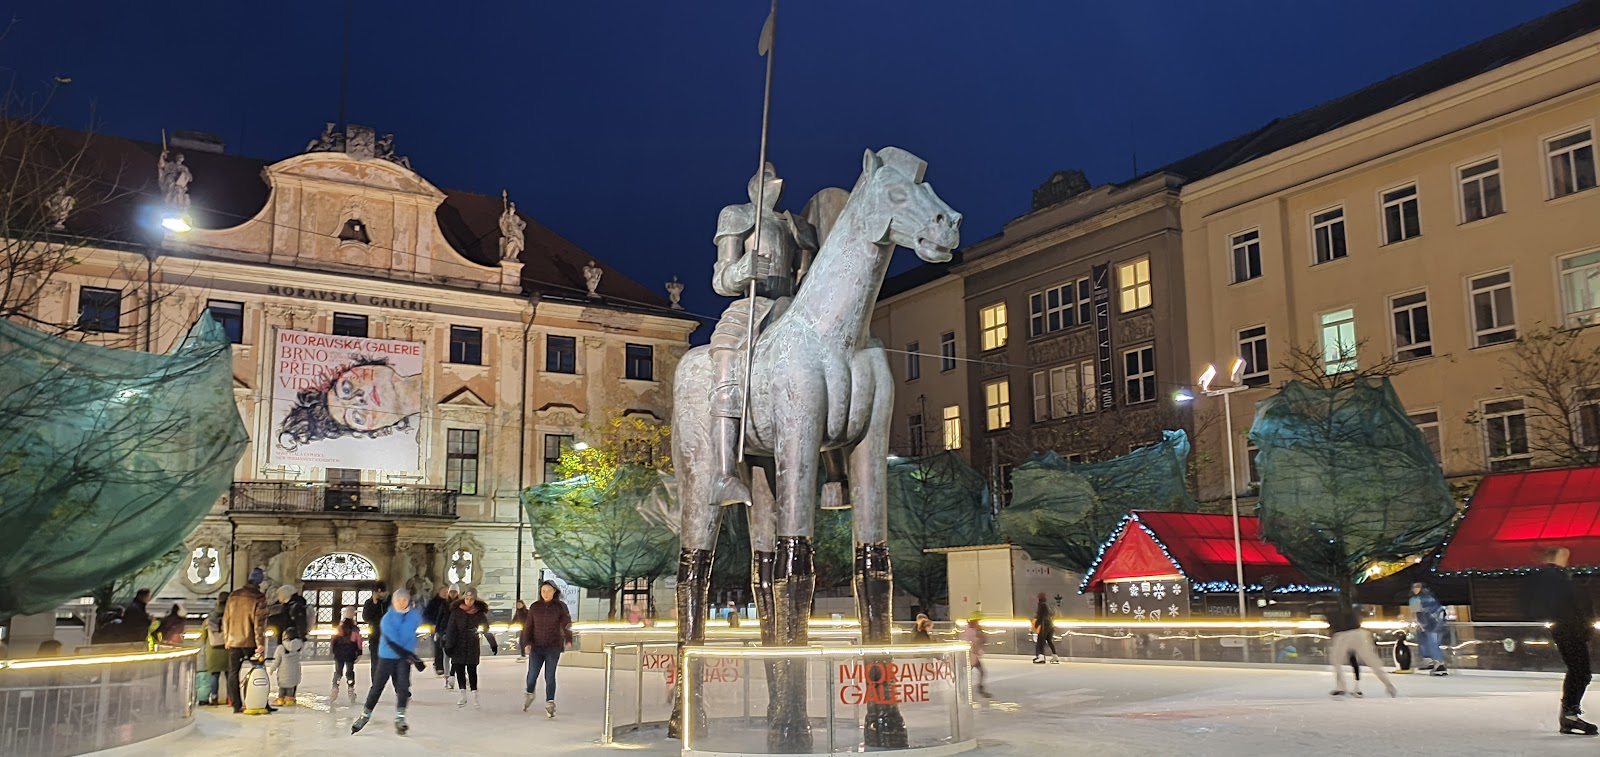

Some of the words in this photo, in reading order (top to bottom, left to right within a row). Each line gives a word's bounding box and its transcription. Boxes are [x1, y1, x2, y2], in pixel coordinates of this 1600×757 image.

[268, 285, 358, 304] MORAVSKÁ
[369, 297, 432, 311] GALERIE
[280, 333, 362, 350] MORAVSKÁ
[366, 342, 420, 355] GALERIE
[281, 346, 328, 362] BRNO
[1209, 606, 1239, 616] HRANOLK
[839, 656, 953, 684] MORAVSKÁ
[840, 683, 930, 705] GALERIE
